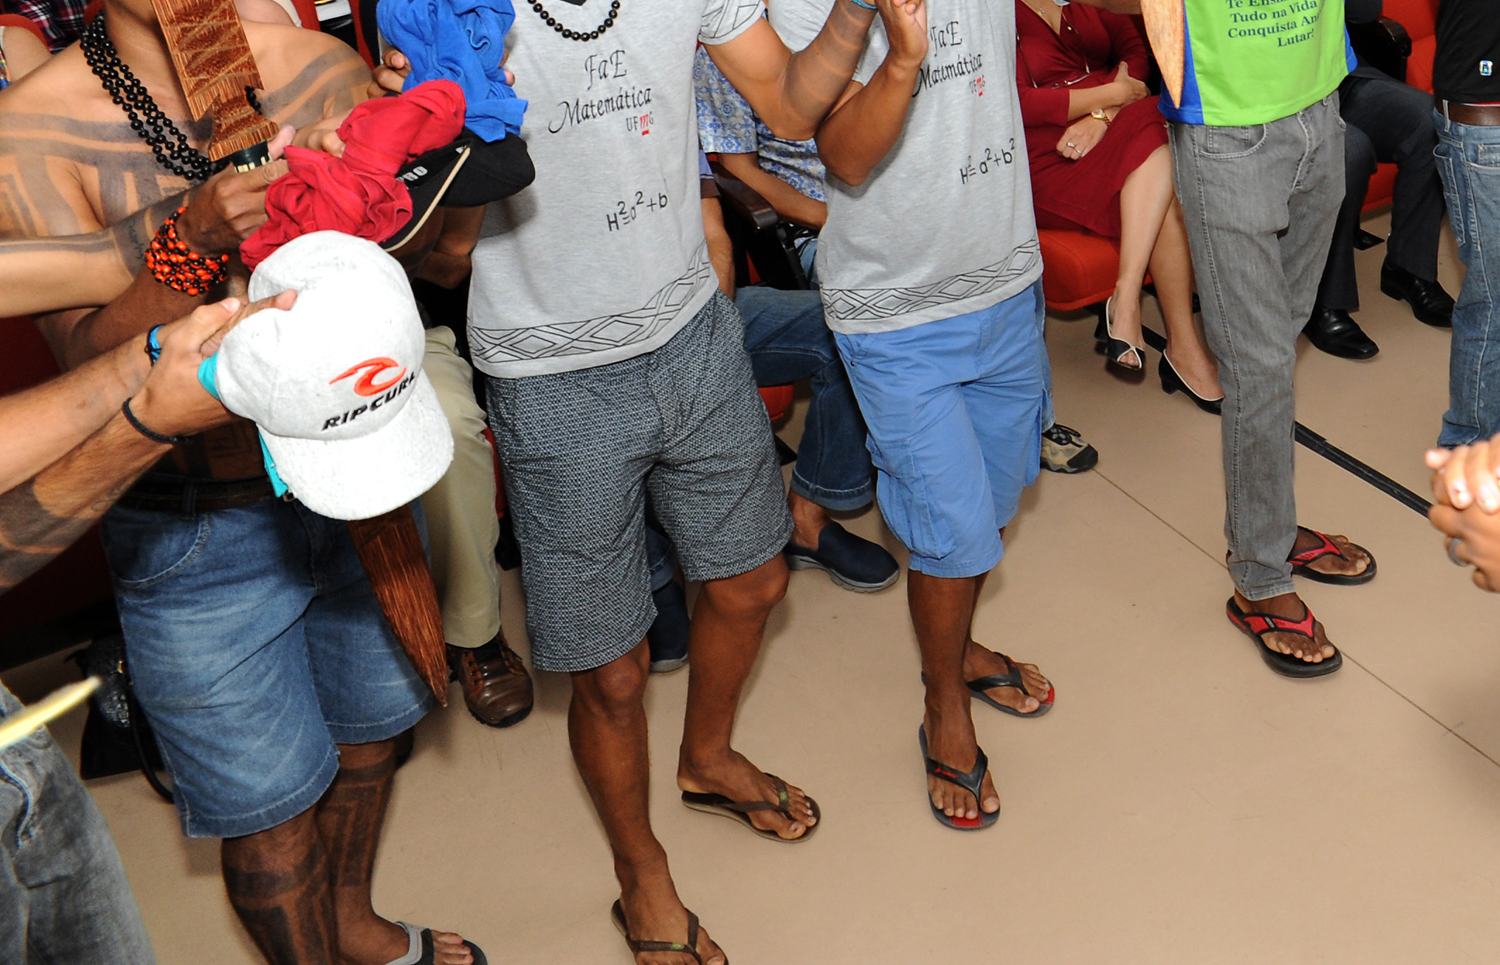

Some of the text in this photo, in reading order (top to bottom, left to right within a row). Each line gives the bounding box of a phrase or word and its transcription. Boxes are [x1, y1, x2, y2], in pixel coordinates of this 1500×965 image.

[1230, 10, 1268, 24] Tudo
[1272, 8, 1287, 19] na
[1288, 0, 1318, 14] Vida
[1227, 20, 1298, 38] Conquista
[1277, 28, 1315, 47] Lutar!
[584, 49, 627, 91] FaE
[911, 53, 983, 98] Matemática
[547, 86, 652, 134] Matemática
